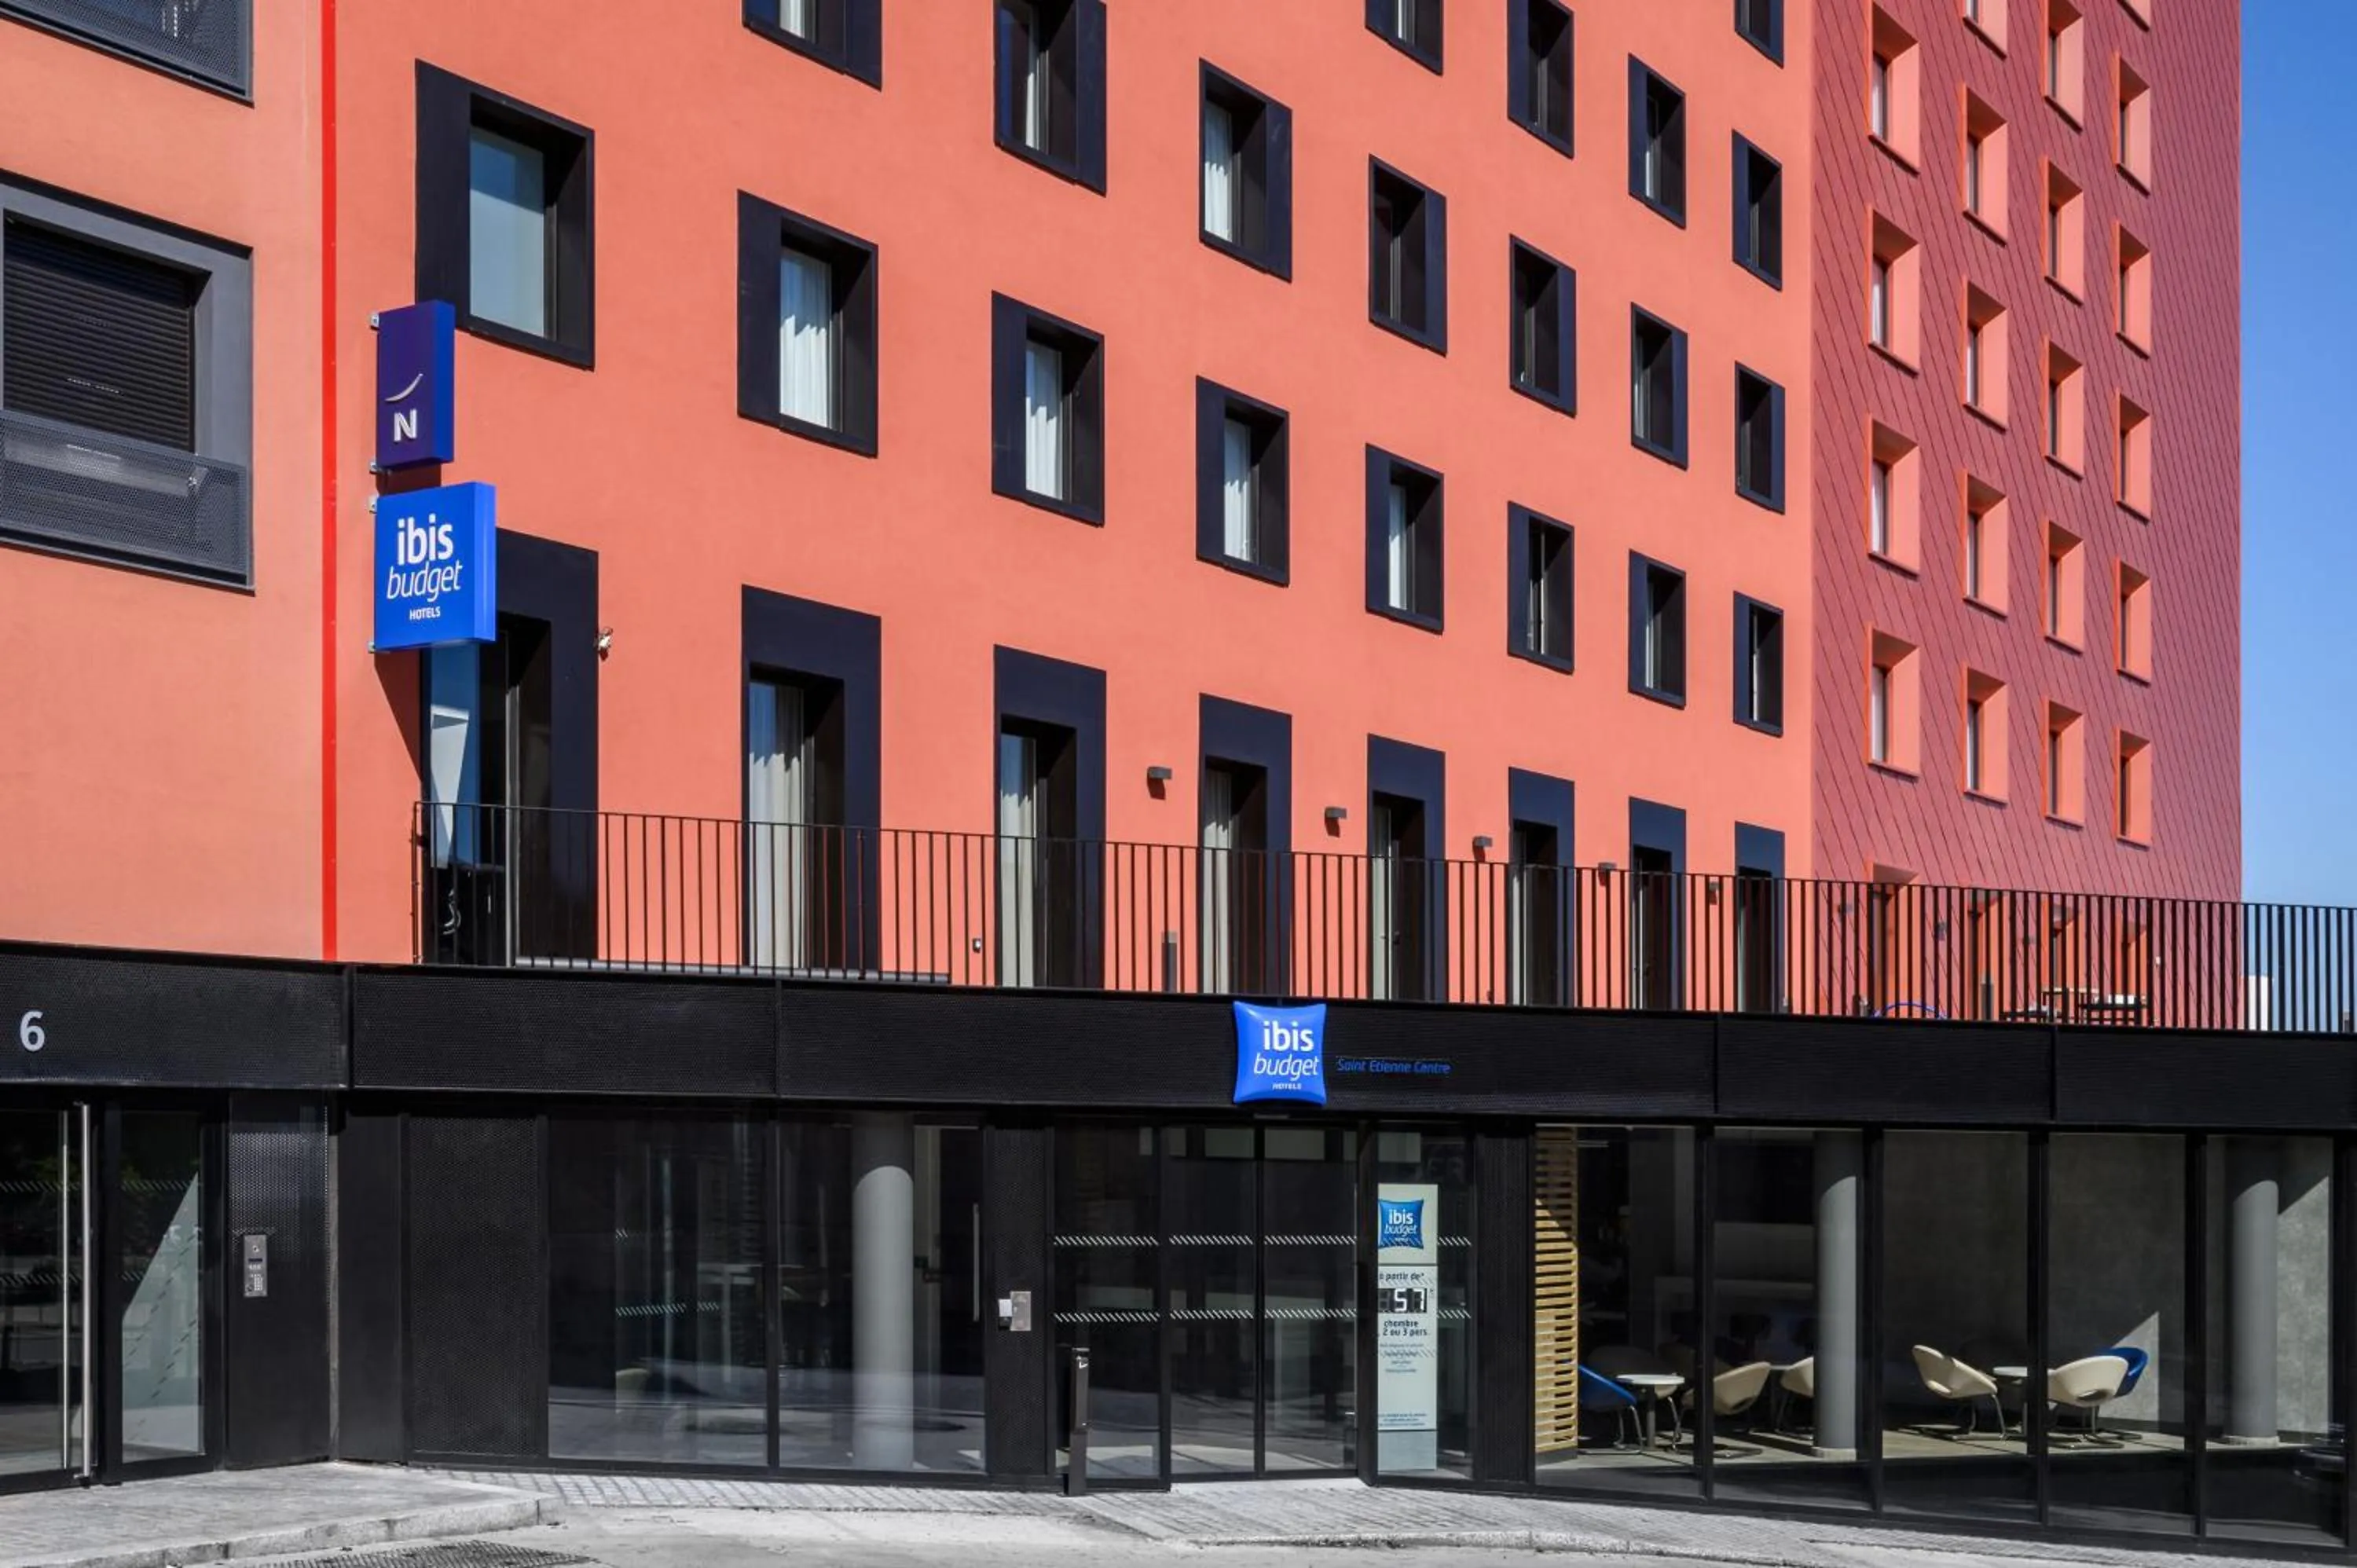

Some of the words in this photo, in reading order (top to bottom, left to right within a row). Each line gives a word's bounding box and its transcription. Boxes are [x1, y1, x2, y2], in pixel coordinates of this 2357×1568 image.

[394, 408, 416, 441] N
[397, 513, 453, 566] ibis
[387, 559, 463, 603] budget
[409, 606, 441, 621] HOTELS
[20, 1010, 45, 1052] 6
[1263, 1021, 1314, 1052] ibis
[1253, 1052, 1319, 1082] budget
[1383, 1223, 1417, 1237] budget
[1388, 1208, 1413, 1225] ibis
[1394, 1288, 1424, 1312] 57
